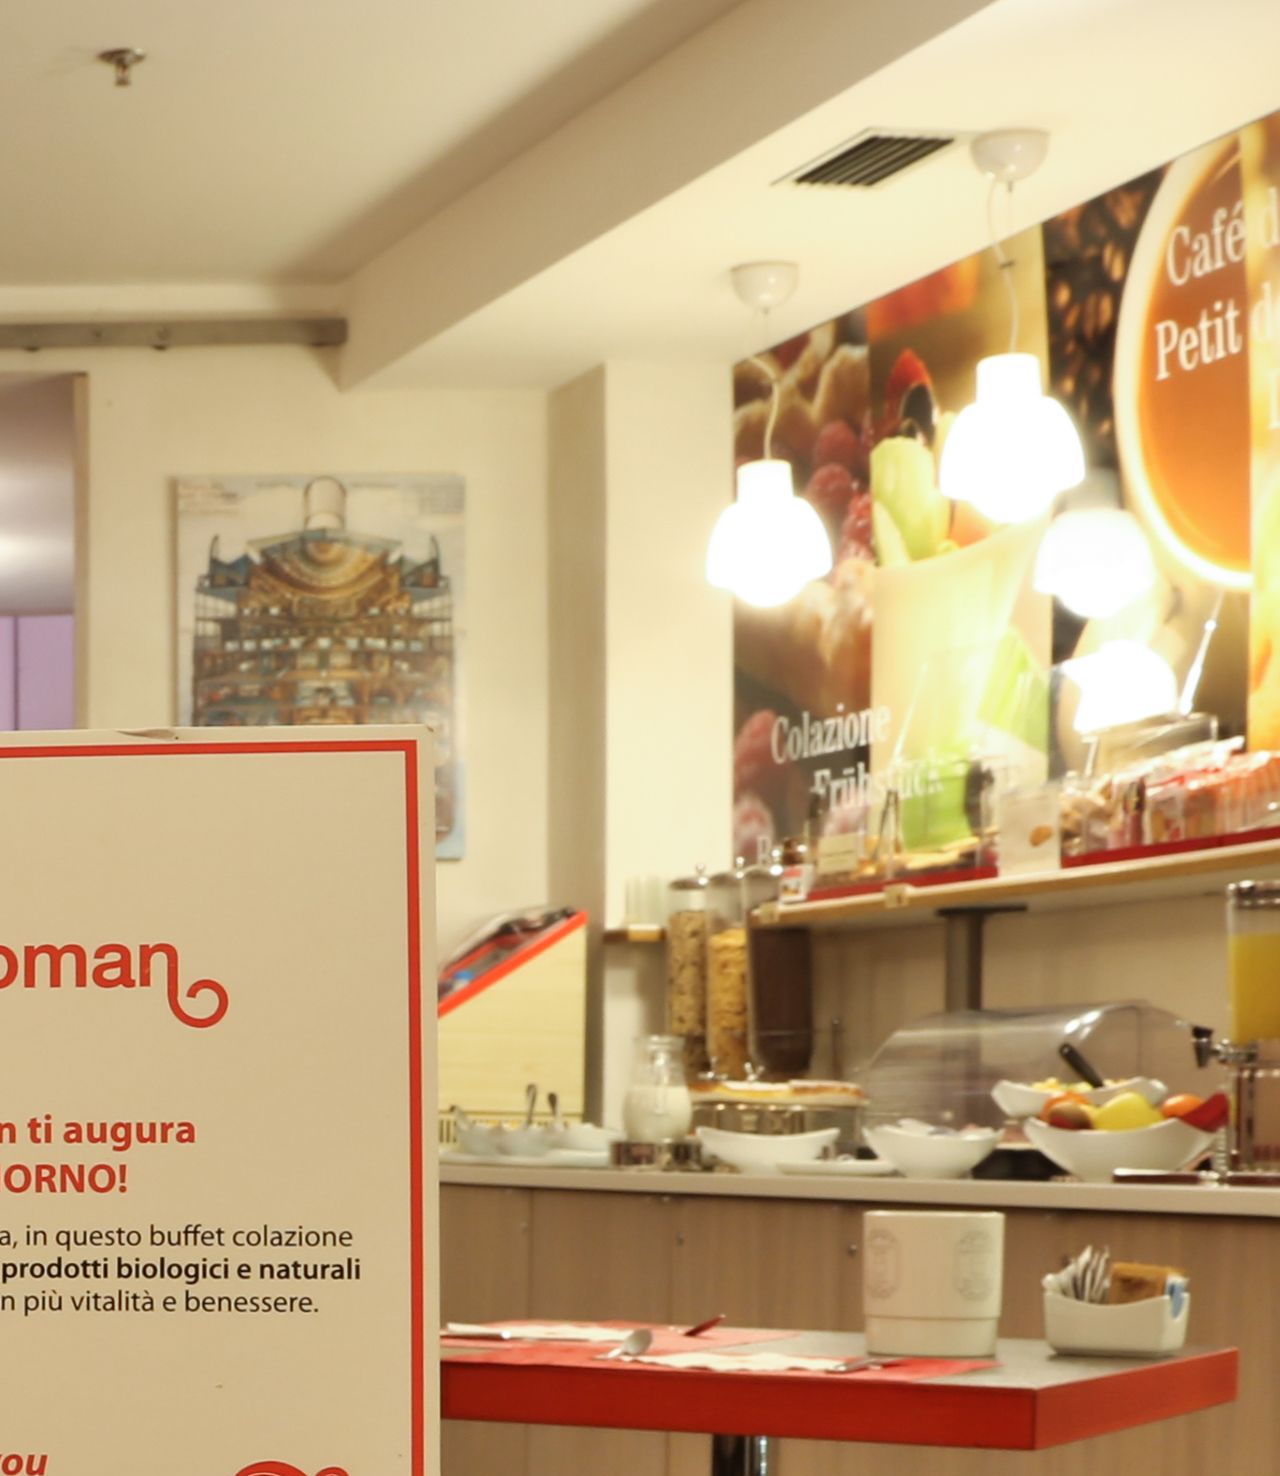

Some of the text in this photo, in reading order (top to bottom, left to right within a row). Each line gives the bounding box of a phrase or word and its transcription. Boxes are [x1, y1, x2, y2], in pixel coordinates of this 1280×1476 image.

[1166, 200, 1246, 286] Café
[1155, 298, 1243, 381] Petit
[771, 702, 891, 764] Colazione
[27, 1114, 52, 1144] ti
[63, 1122, 195, 1152] augura
[26, 1225, 47, 1246] in
[55, 1227, 142, 1252] questo
[150, 1224, 225, 1246] buffet
[232, 1224, 353, 1247] colazione
[2, 1256, 108, 1284] prodotti
[117, 1256, 229, 1285] biologici
[237, 1263, 252, 1279] e
[260, 1257, 360, 1280] naturali
[24, 1289, 62, 1317] più
[70, 1289, 154, 1312] vitalità
[162, 1296, 177, 1312] e
[185, 1289, 319, 1313] benessere.
